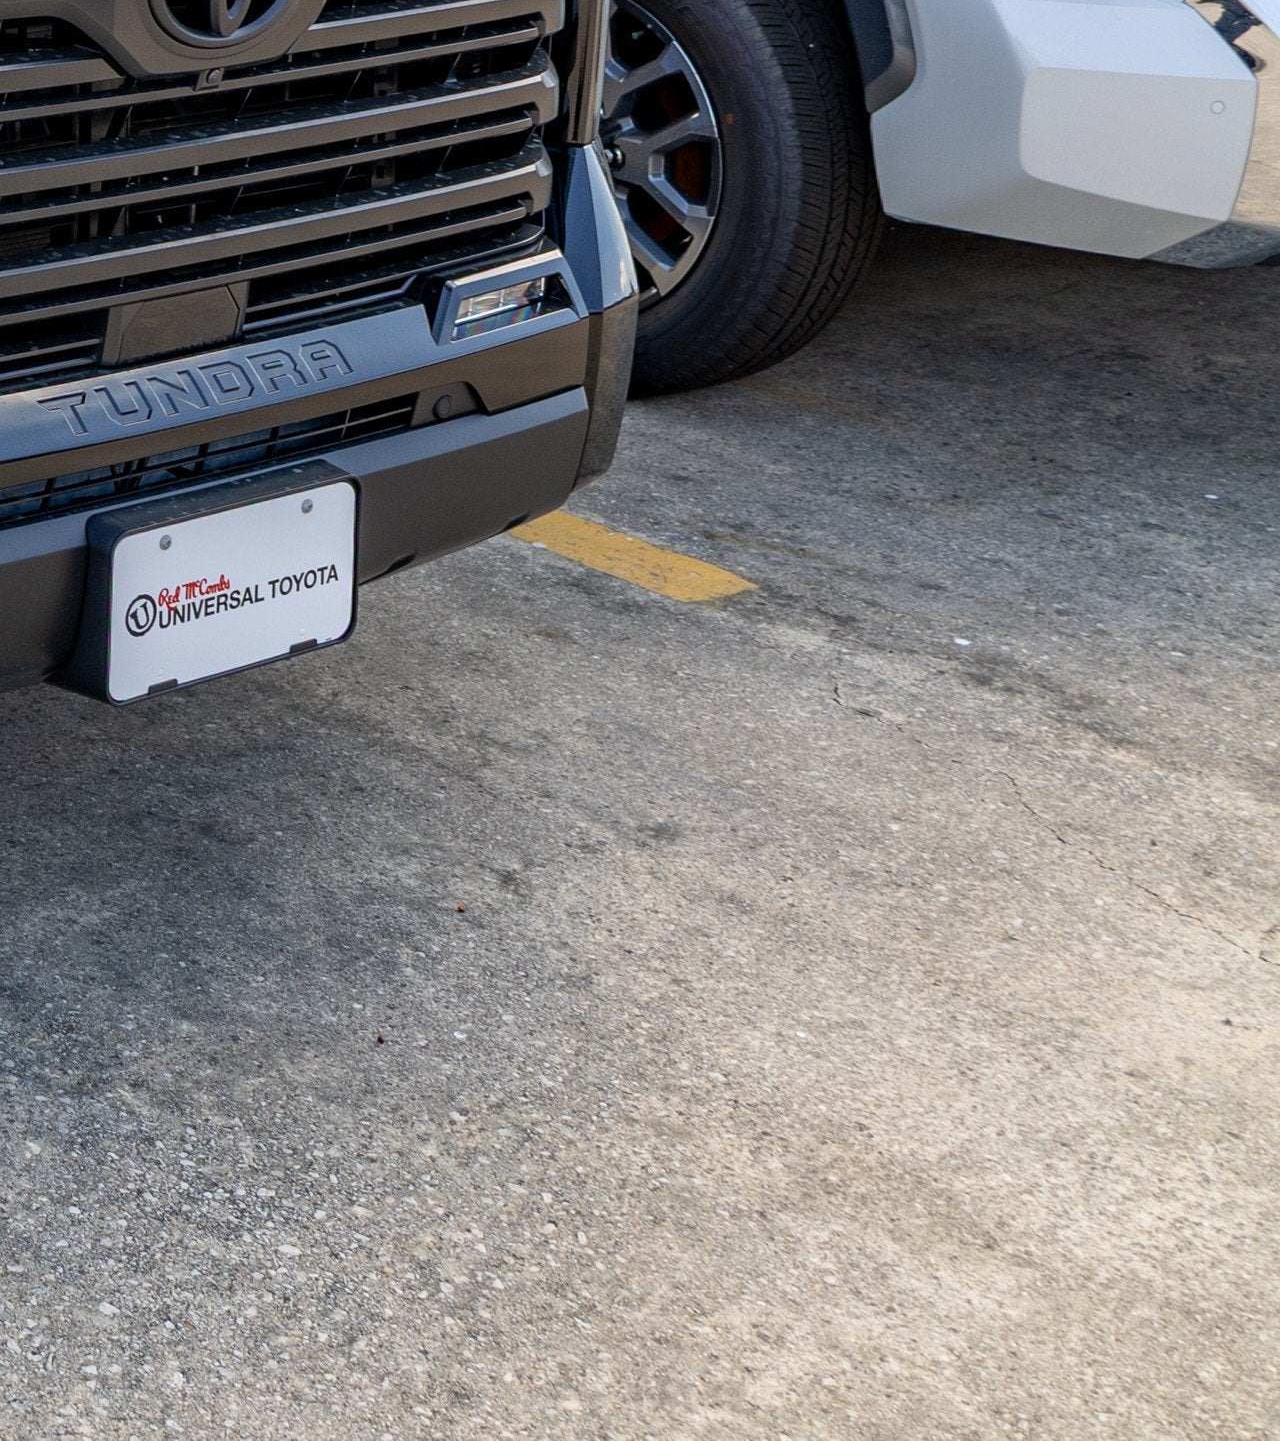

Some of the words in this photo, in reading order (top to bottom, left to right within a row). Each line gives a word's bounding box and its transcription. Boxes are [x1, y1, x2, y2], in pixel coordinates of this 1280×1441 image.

[34, 338, 354, 437] TUNDRA
[158, 586, 181, 611] Red
[182, 573, 230, 600] McCombs
[158, 584, 265, 629] UNIVERSAL
[268, 564, 339, 599] TOYOTA
